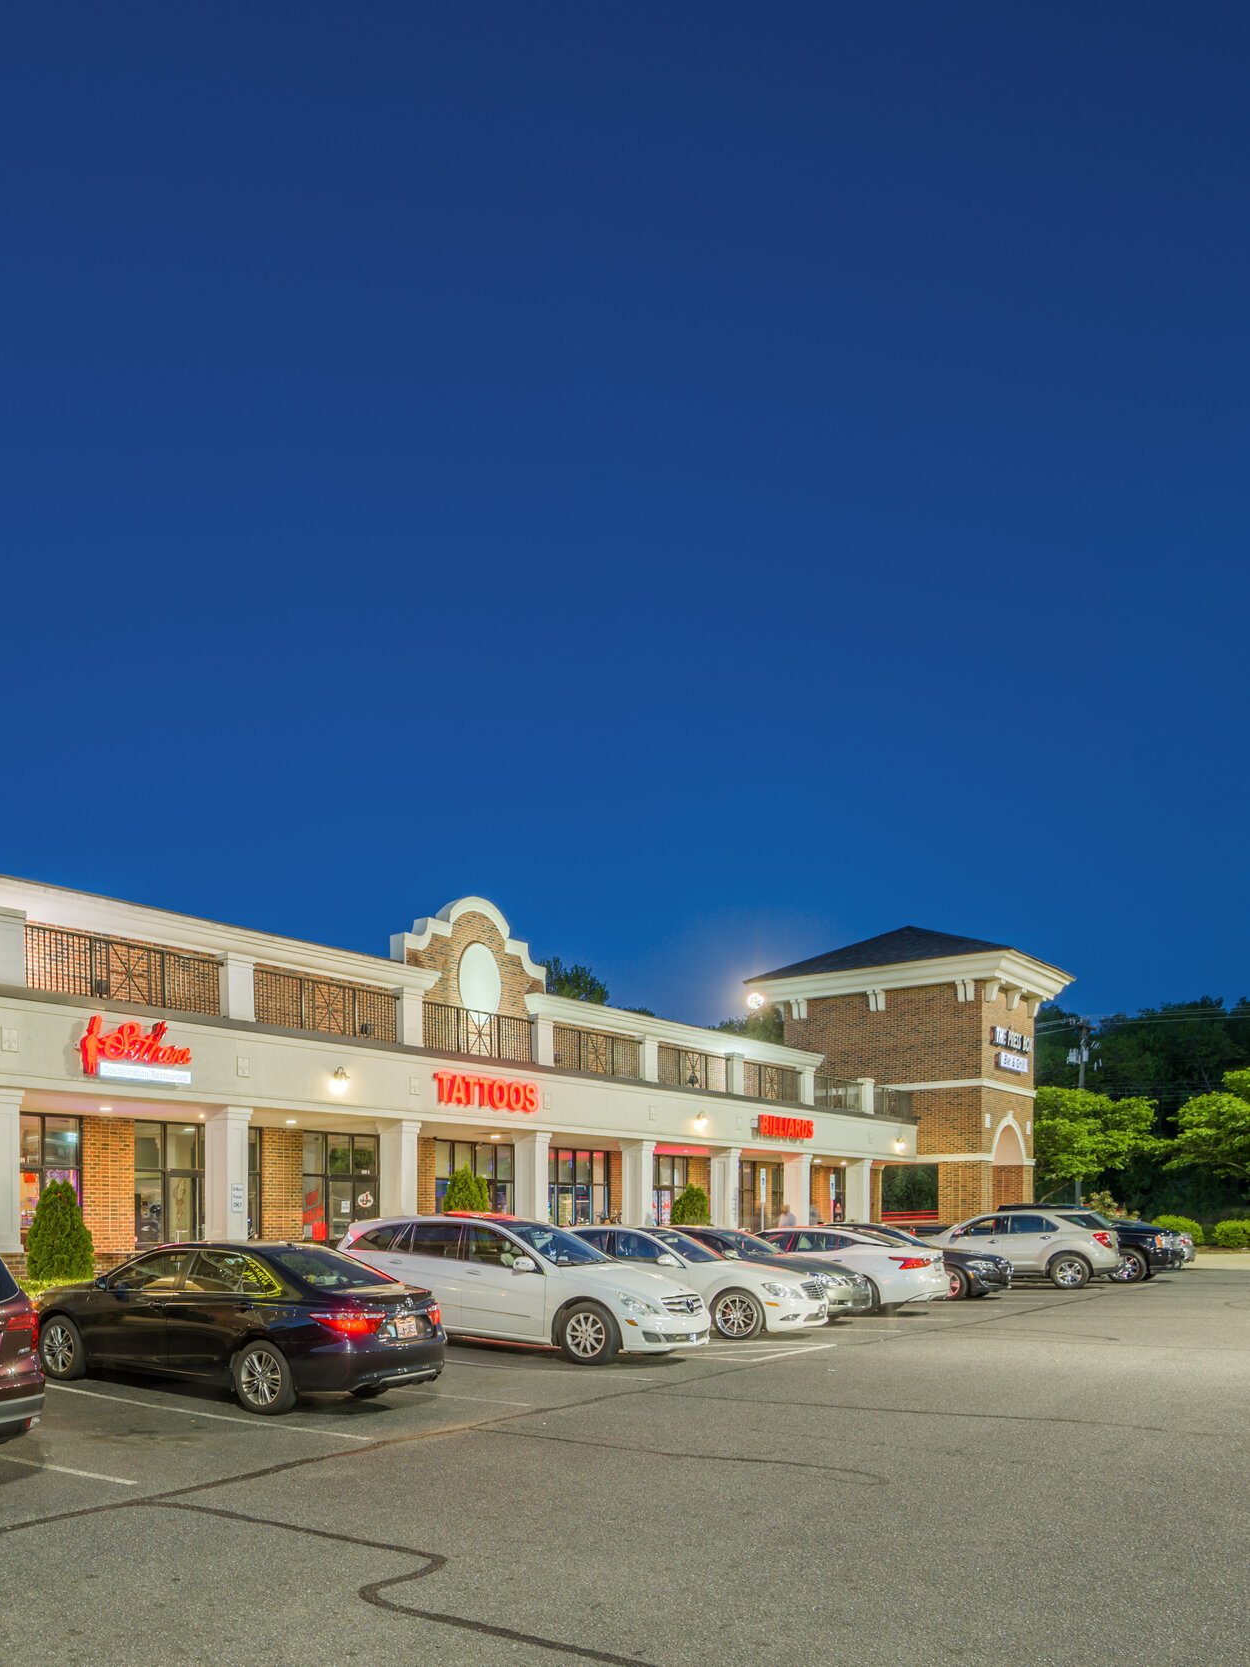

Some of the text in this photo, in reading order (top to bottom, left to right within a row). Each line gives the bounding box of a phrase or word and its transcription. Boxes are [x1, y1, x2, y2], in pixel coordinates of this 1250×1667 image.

[1007, 1030, 1022, 1050] PRESS
[103, 1065, 188, 1082] South Indian Restaurant
[434, 1071, 539, 1113] TATTOOS
[760, 1114, 814, 1139] BILLIARDS
